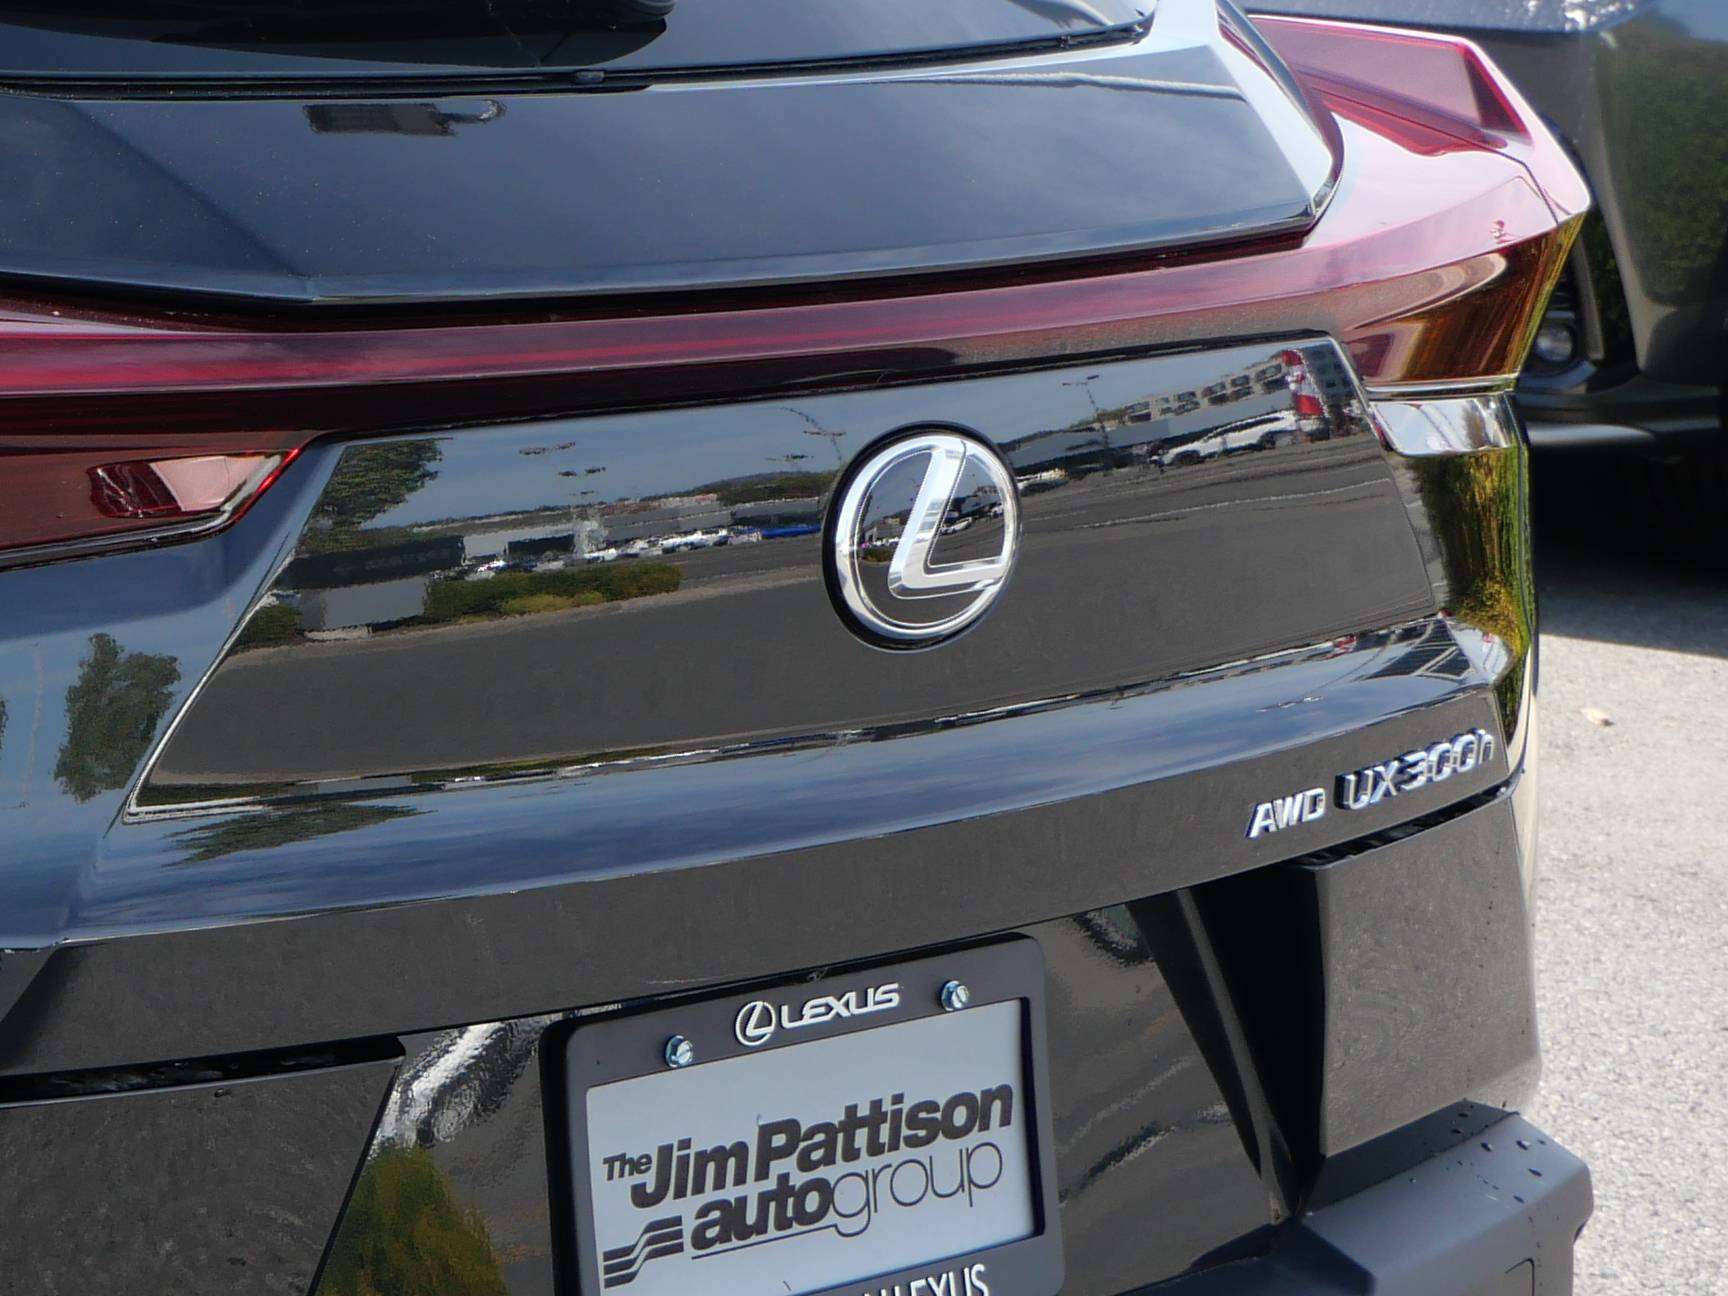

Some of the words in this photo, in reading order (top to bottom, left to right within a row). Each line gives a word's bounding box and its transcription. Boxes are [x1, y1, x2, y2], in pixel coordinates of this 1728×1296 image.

[1246, 787, 1326, 840] AWD
[1337, 727, 1494, 811] UX300h
[781, 982, 900, 1029] LEXUS
[602, 1150, 652, 1182] The
